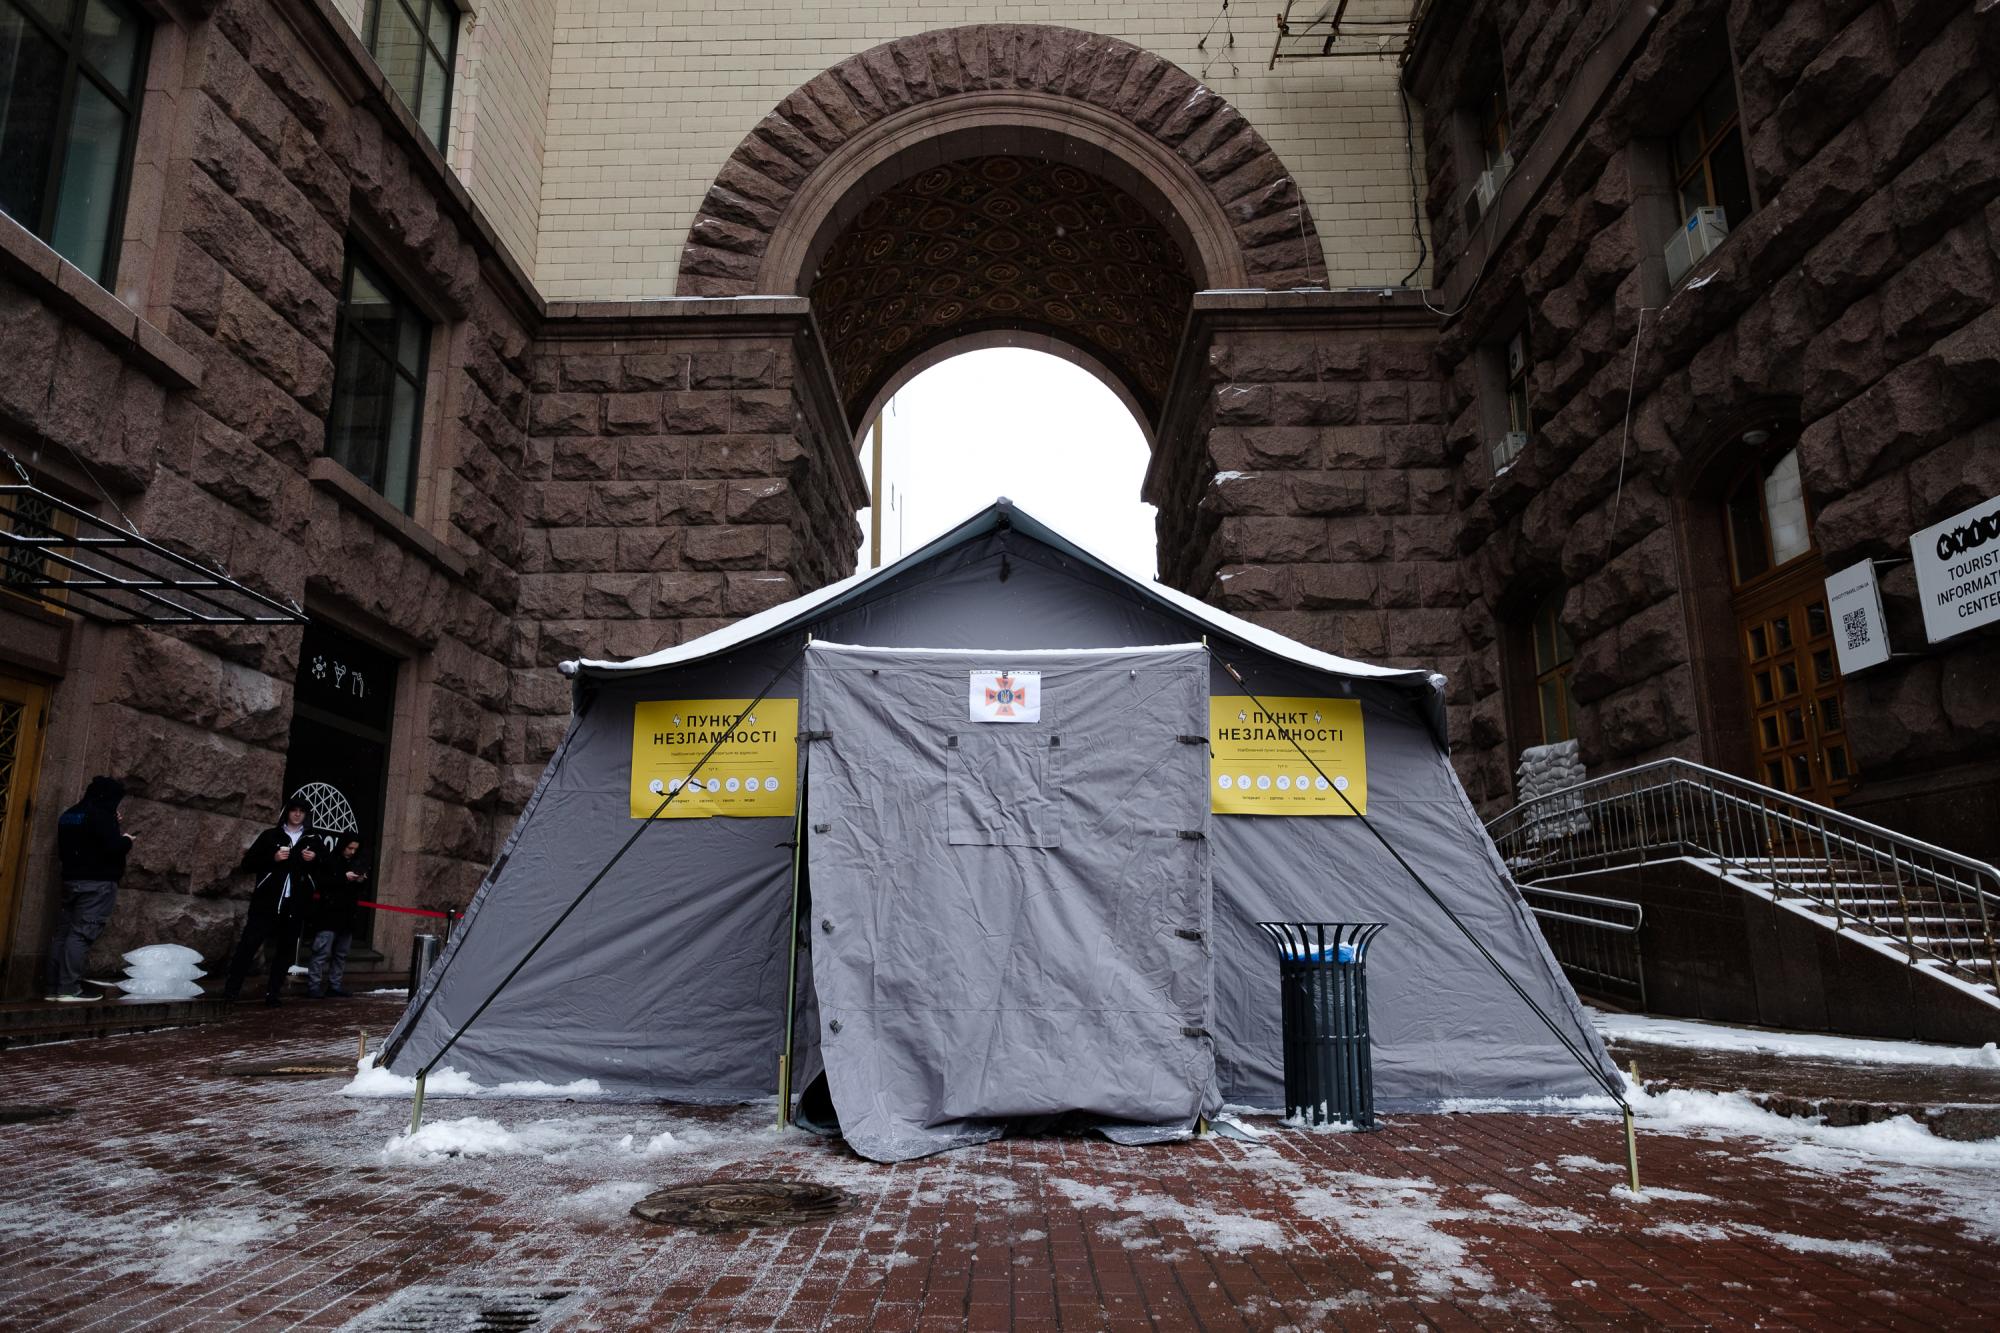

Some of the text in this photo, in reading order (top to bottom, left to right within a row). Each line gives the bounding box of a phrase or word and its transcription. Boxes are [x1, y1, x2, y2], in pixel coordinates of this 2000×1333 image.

[1940, 517, 1997, 555] KYIV
[1947, 549, 1999, 581] TOURIST
[687, 714, 743, 727] ПУНКТ
[1253, 711, 1309, 724] ПУНКТ
[653, 730, 777, 745] НЕЗЛАМНОСТІ
[1218, 728, 1343, 742] НЕЗЛАМНОСТІ
